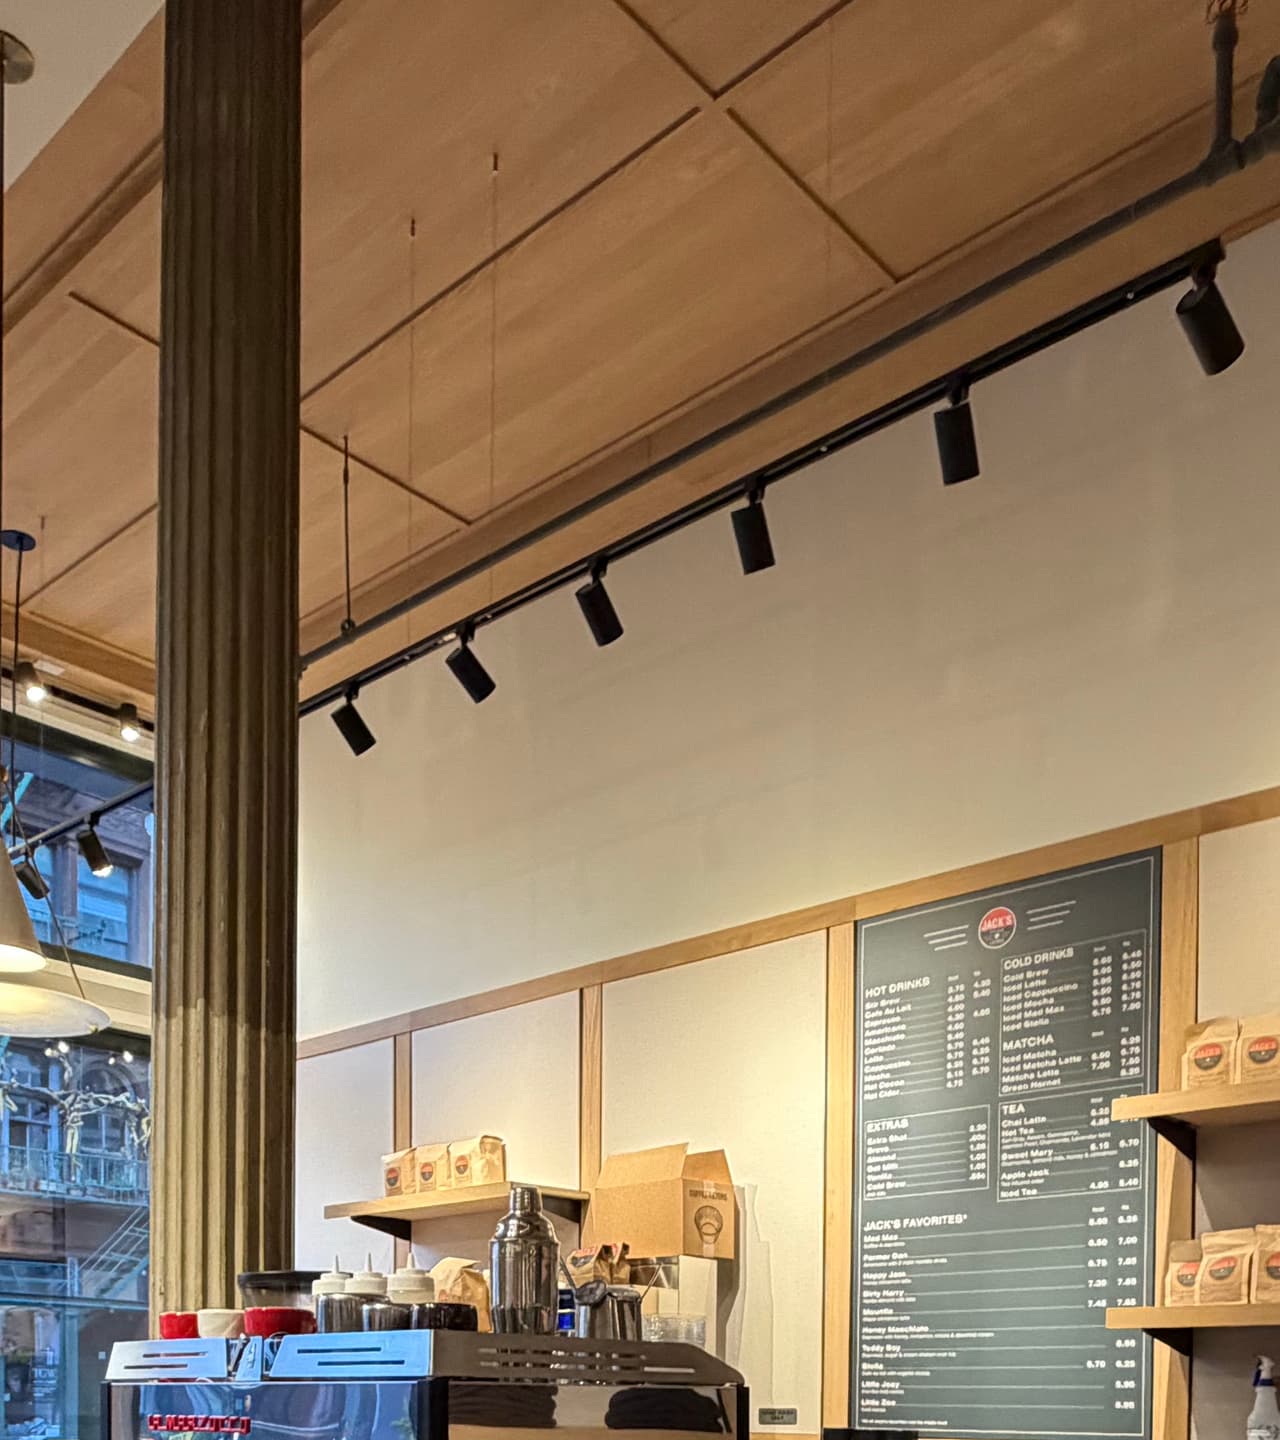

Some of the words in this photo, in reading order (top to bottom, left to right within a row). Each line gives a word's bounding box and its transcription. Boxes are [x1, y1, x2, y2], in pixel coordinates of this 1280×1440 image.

[980, 914, 1013, 932] JACK'S
[1003, 956, 1031, 970] COLD
[1034, 947, 1073, 963] DRINKS
[1003, 972, 1024, 983] Cold
[1025, 967, 1048, 978] Brew
[865, 985, 886, 998] HOT
[888, 976, 929, 993] DRINKS
[1003, 982, 1022, 993] Iced
[1003, 992, 1022, 1003] Iced
[1003, 1002, 1022, 1012] Iced
[1002, 1012, 1022, 1022] Iced
[1002, 1022, 1021, 1032] Iced
[1002, 1033, 1054, 1051] MATCHA
[1002, 1054, 1021, 1064] Iced
[1002, 1064, 1021, 1074] Iced
[1001, 1103, 1025, 1115] TEA
[866, 1118, 908, 1133] EXTRAS
[1001, 1117, 1022, 1128] Chai
[1030, 1147, 1053, 1158] Mary
[1000, 1170, 1026, 1181] Apple
[1028, 1168, 1049, 1177] Jack
[863, 1219, 900, 1231] JACK'S
